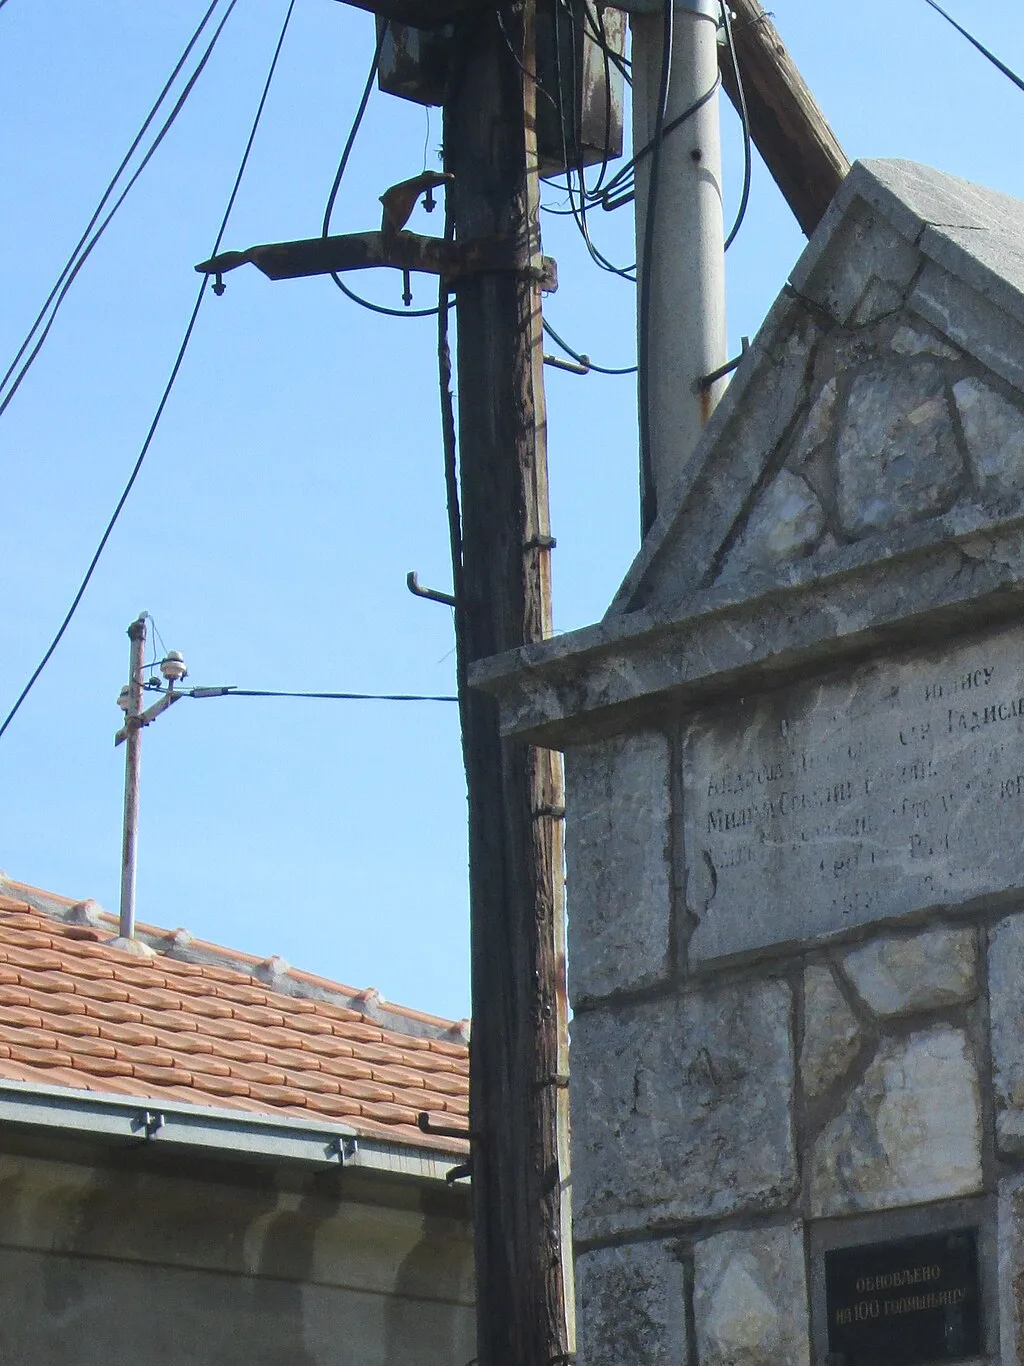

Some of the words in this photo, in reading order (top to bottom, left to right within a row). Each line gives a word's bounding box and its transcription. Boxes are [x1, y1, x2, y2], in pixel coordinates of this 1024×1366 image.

[855, 1264, 941, 1293] ОБНОВЉЕНО
[835, 1307, 852, 1326] НА
[854, 1299, 880, 1321] 100
